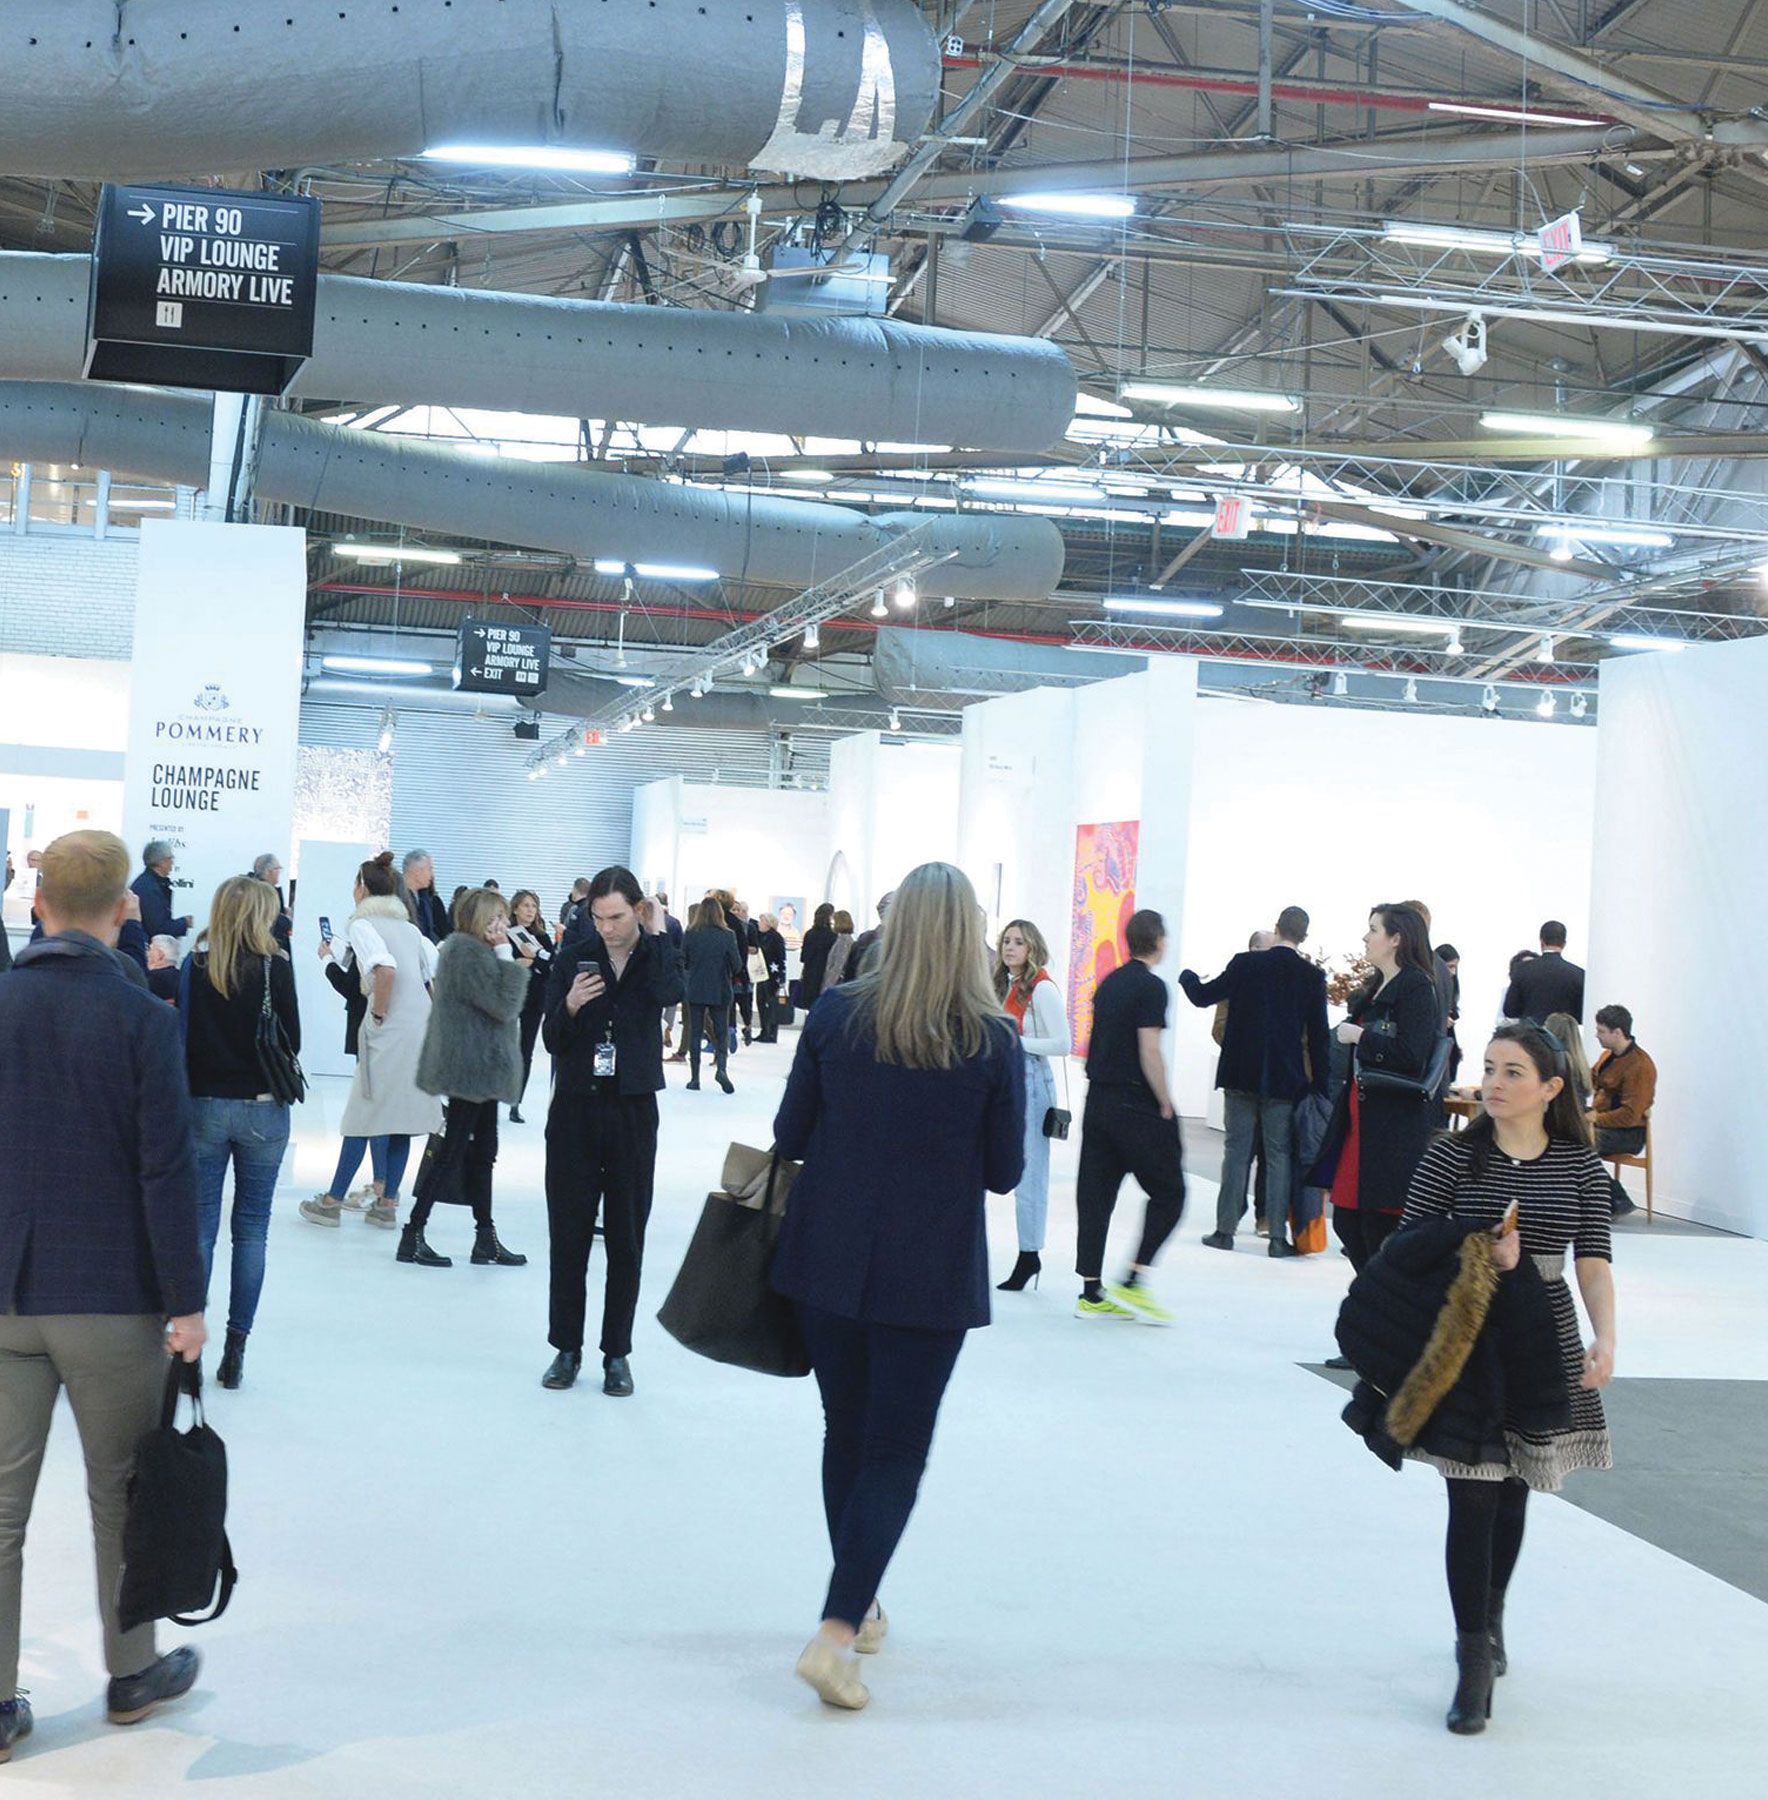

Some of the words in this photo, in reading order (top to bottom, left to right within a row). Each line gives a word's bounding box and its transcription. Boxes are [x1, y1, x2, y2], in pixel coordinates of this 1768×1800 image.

[162, 203, 208, 232] PIER
[214, 207, 242, 235] 90
[160, 235, 194, 263] VIP
[200, 239, 280, 271] LOUNGE
[156, 268, 244, 300] ARMORY
[249, 276, 293, 305] LIVE
[1216, 501, 1241, 533] EXIT
[487, 628, 507, 642] PIER
[486, 641, 501, 653] VIP
[502, 643, 535, 657] LOUNGE
[484, 654, 520, 668] ARMORY
[521, 657, 540, 671] LIVE
[484, 667, 504, 680] EXIT
[156, 721, 264, 744] POMMERY
[152, 763, 261, 791] CHAMPAGNE
[151, 786, 220, 811] LOUNGE
